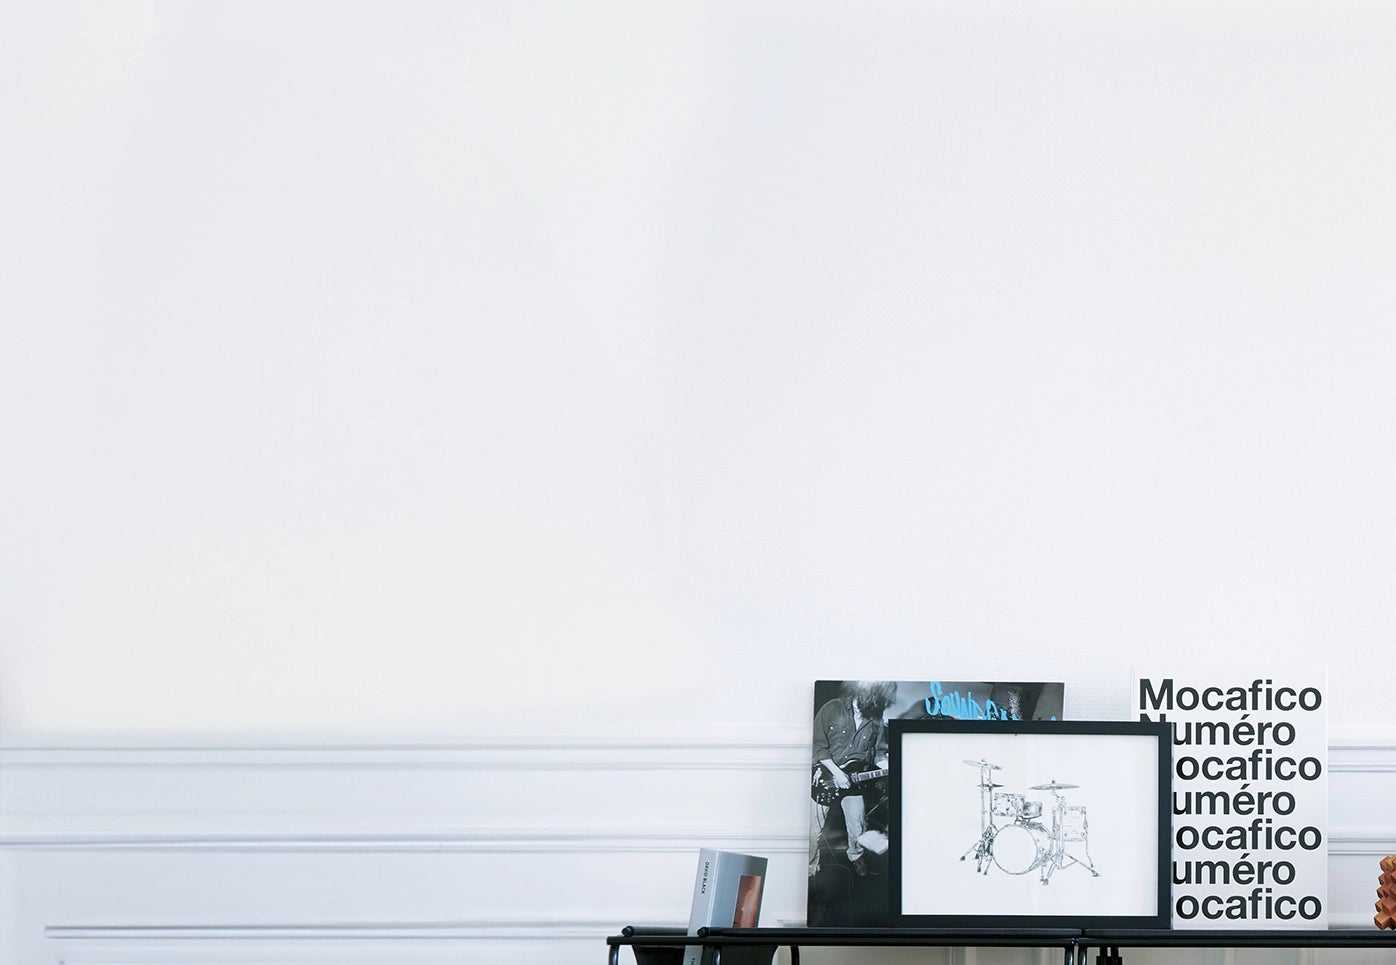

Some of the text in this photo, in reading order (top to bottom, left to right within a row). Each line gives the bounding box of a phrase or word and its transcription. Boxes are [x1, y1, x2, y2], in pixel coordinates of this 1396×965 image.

[1139, 678, 1322, 711] Mocafico
[1176, 749, 1322, 780] ocafico
[1173, 783, 1296, 815] uméro
[1176, 818, 1322, 850] ocafico
[1173, 853, 1296, 885] uméro
[1176, 888, 1322, 920] ocafico
